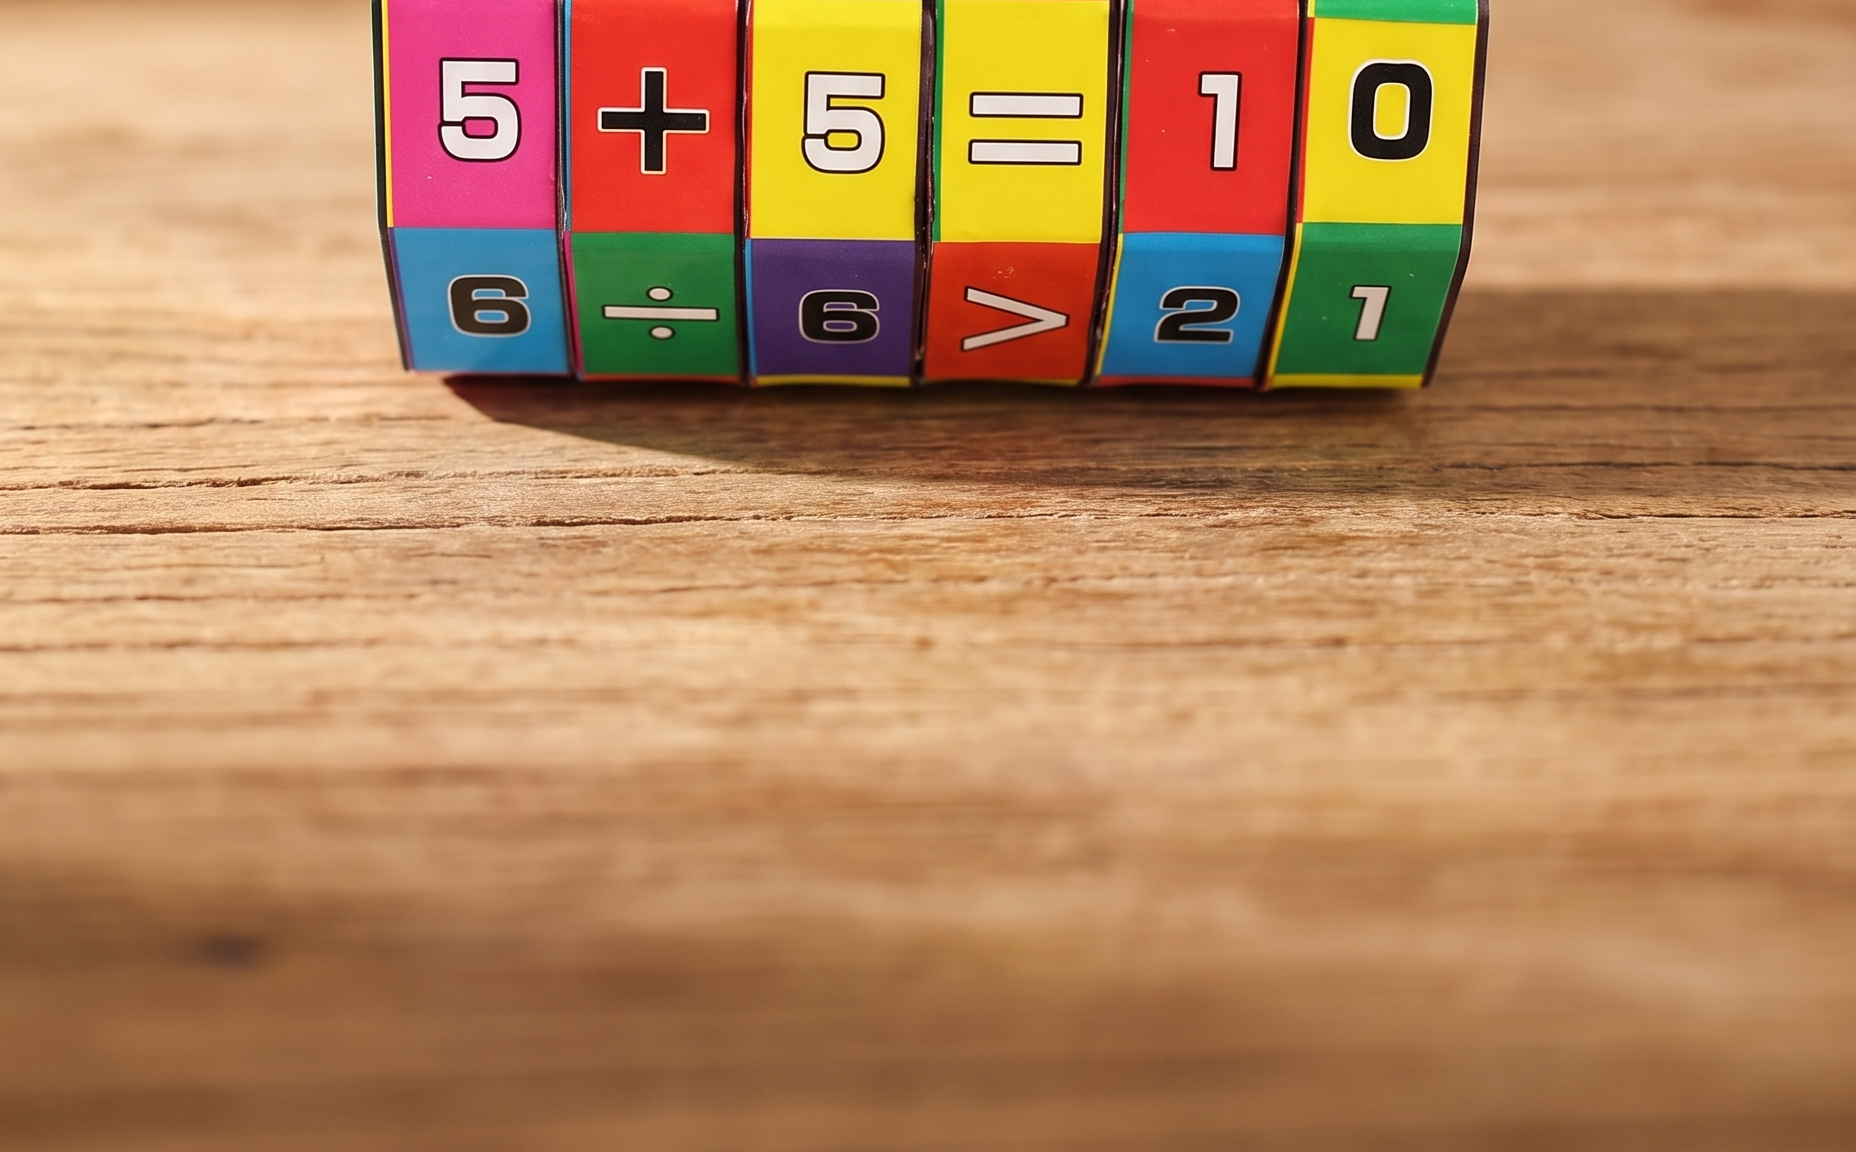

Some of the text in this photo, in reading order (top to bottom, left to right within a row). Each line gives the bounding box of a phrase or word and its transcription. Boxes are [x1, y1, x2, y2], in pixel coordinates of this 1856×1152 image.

[438, 57, 1434, 175] 5 + 5 = 1 0
[447, 274, 1392, 351] 6 ÷ 6 > 2 1
